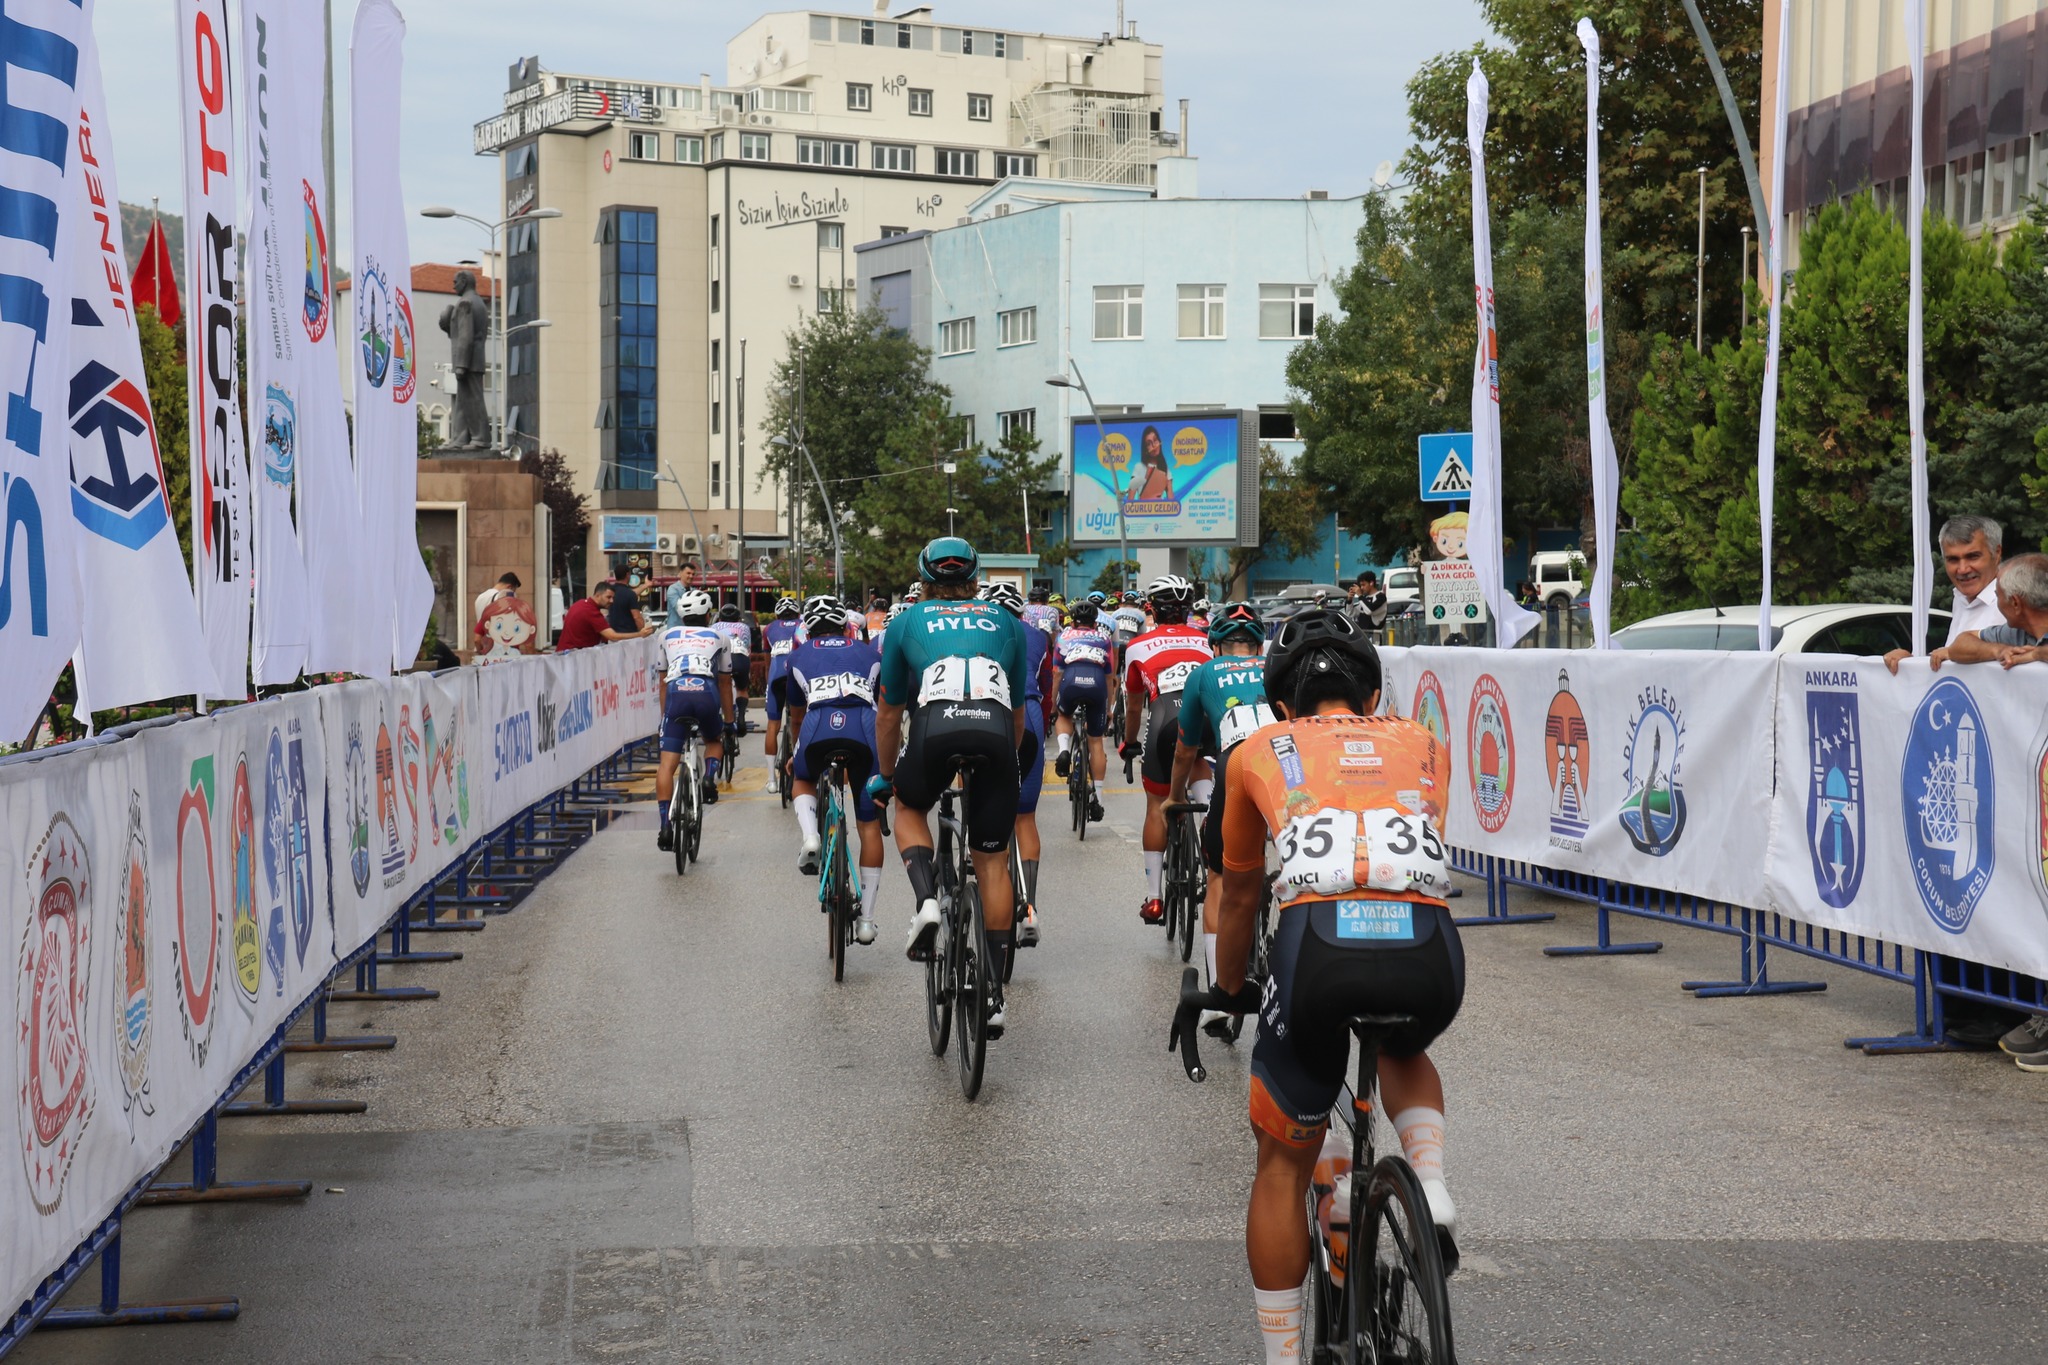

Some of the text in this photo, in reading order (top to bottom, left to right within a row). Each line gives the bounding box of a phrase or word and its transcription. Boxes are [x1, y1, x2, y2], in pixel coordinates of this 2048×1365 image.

[526, 83, 541, 98] ÖZEL
[475, 91, 572, 152] KARATEKİN HASTANESİ
[738, 188, 849, 225] Sizin İçin Sizinle
[195, 0, 233, 583] SPOR TO
[271, 307, 283, 360] Samsun
[282, 312, 293, 361] Samsun
[1103, 455, 1126, 464] KDRO
[1125, 502, 1179, 513] UĞURLU GELDİK
[1086, 508, 1120, 531] uğur
[1101, 528, 1115, 536] kurs
[1440, 562, 1467, 570] DİKKAT
[1452, 570, 1476, 579] GEÇİD
[1431, 581, 1479, 592] YAYAYA
[1430, 592, 1458, 605] YEŞİL
[1449, 605, 1462, 616] OL
[926, 617, 997, 634] HYLO
[668, 638, 715, 649] KINAN
[1144, 637, 1209, 651] TÜRKİYE
[841, 672, 873, 693] 125
[932, 664, 946, 686] 2
[988, 664, 1000, 687] 2
[1805, 671, 1858, 687] ANKARA
[808, 675, 837, 694] 125
[933, 688, 946, 696] UCI
[992, 688, 1003, 699] UCI
[955, 708, 991, 717] corendon
[1227, 709, 1238, 729] 1
[1637, 685, 1687, 788] BELEDİYESİ
[1471, 787, 1512, 830] BELEDİYESİ
[1281, 817, 1333, 864] 35
[1385, 816, 1444, 861] 35
[1292, 872, 1320, 886] UCI
[1413, 870, 1436, 886] UCI
[1945, 866, 1987, 922] BELEDİYESİ
[1361, 905, 1410, 919] YATAGAI
